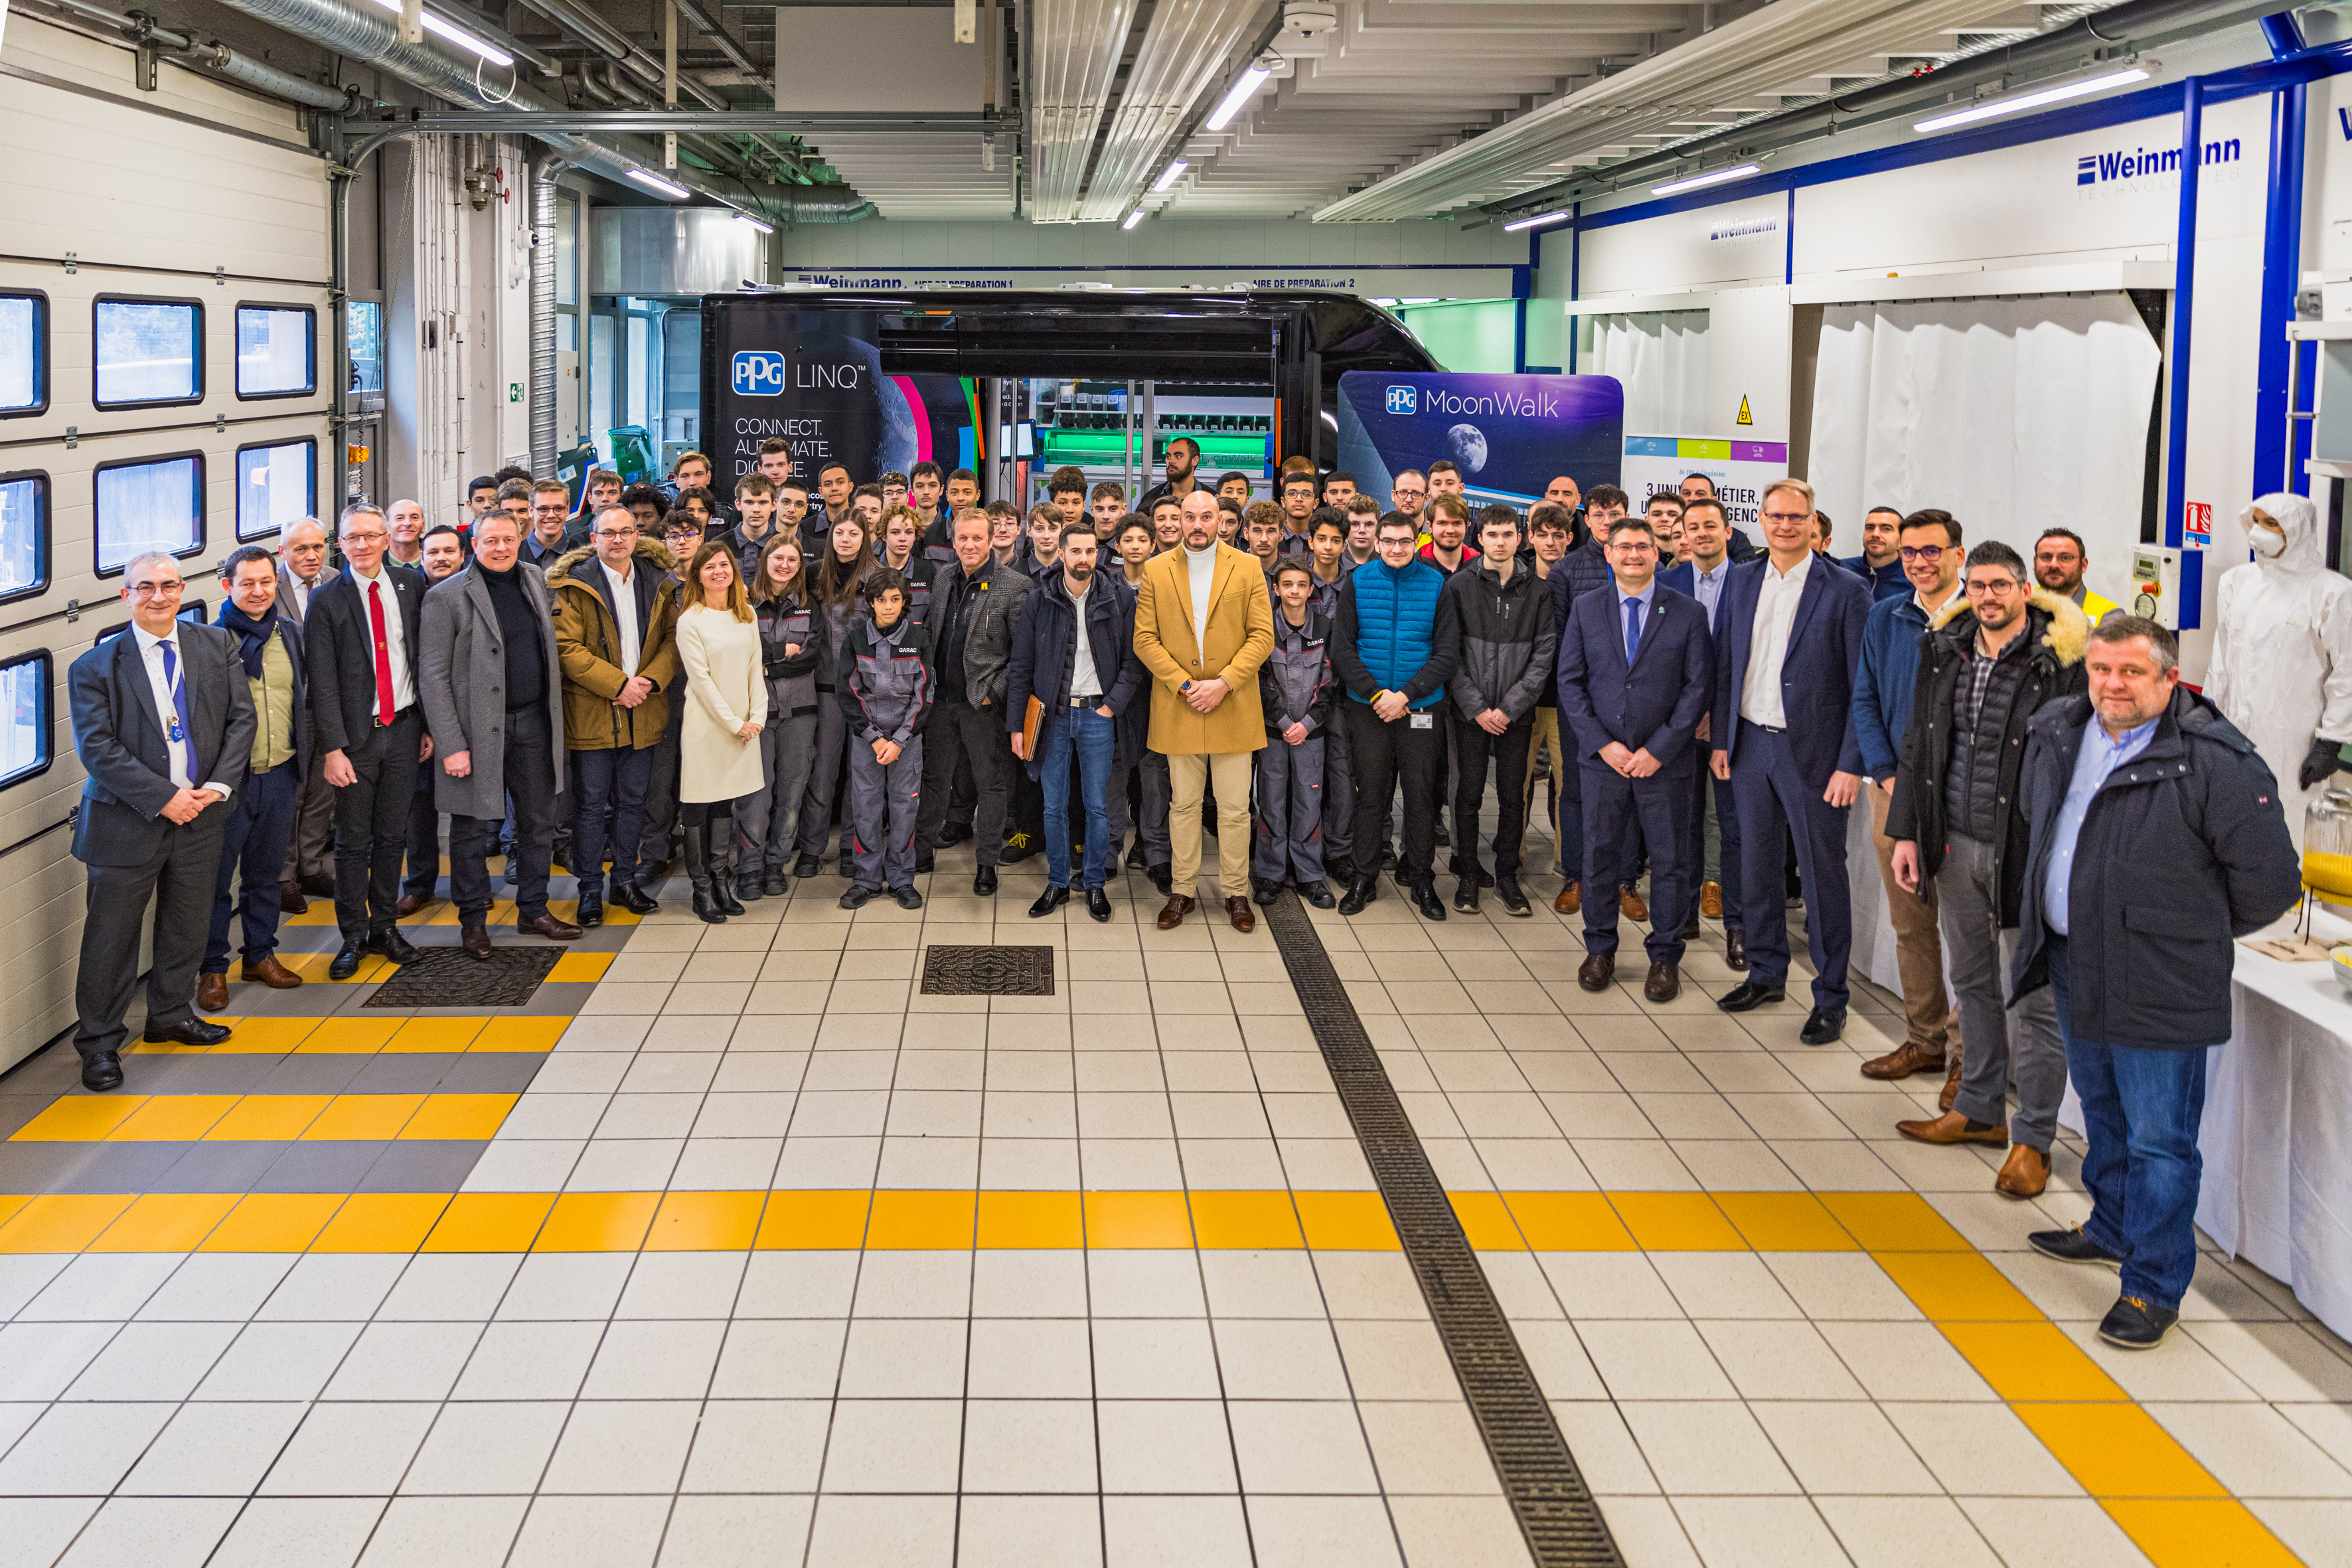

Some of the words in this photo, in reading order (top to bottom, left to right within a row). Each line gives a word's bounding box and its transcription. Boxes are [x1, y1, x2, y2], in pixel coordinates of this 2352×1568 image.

[2098, 137, 2240, 182] Weinmnn
[2077, 167, 2240, 200] TECHNOLOIES
[1719, 215, 1776, 238] Weinmann
[1711, 233, 1776, 250] TECHNOLOGIES
[813, 275, 902, 288] Weinmann
[1253, 279, 1271, 287] AIRE
[1287, 279, 1346, 288] PREPARATION
[1349, 278, 1355, 287] 2
[736, 356, 781, 390] PPG
[1387, 389, 1415, 411] PPG
[1426, 390, 1559, 418] MoonWalk
[1741, 411, 1749, 420] EX
[735, 418, 823, 435] CONNECT.
[1646, 483, 1653, 497] 3
[1306, 638, 1324, 647] GARAC
